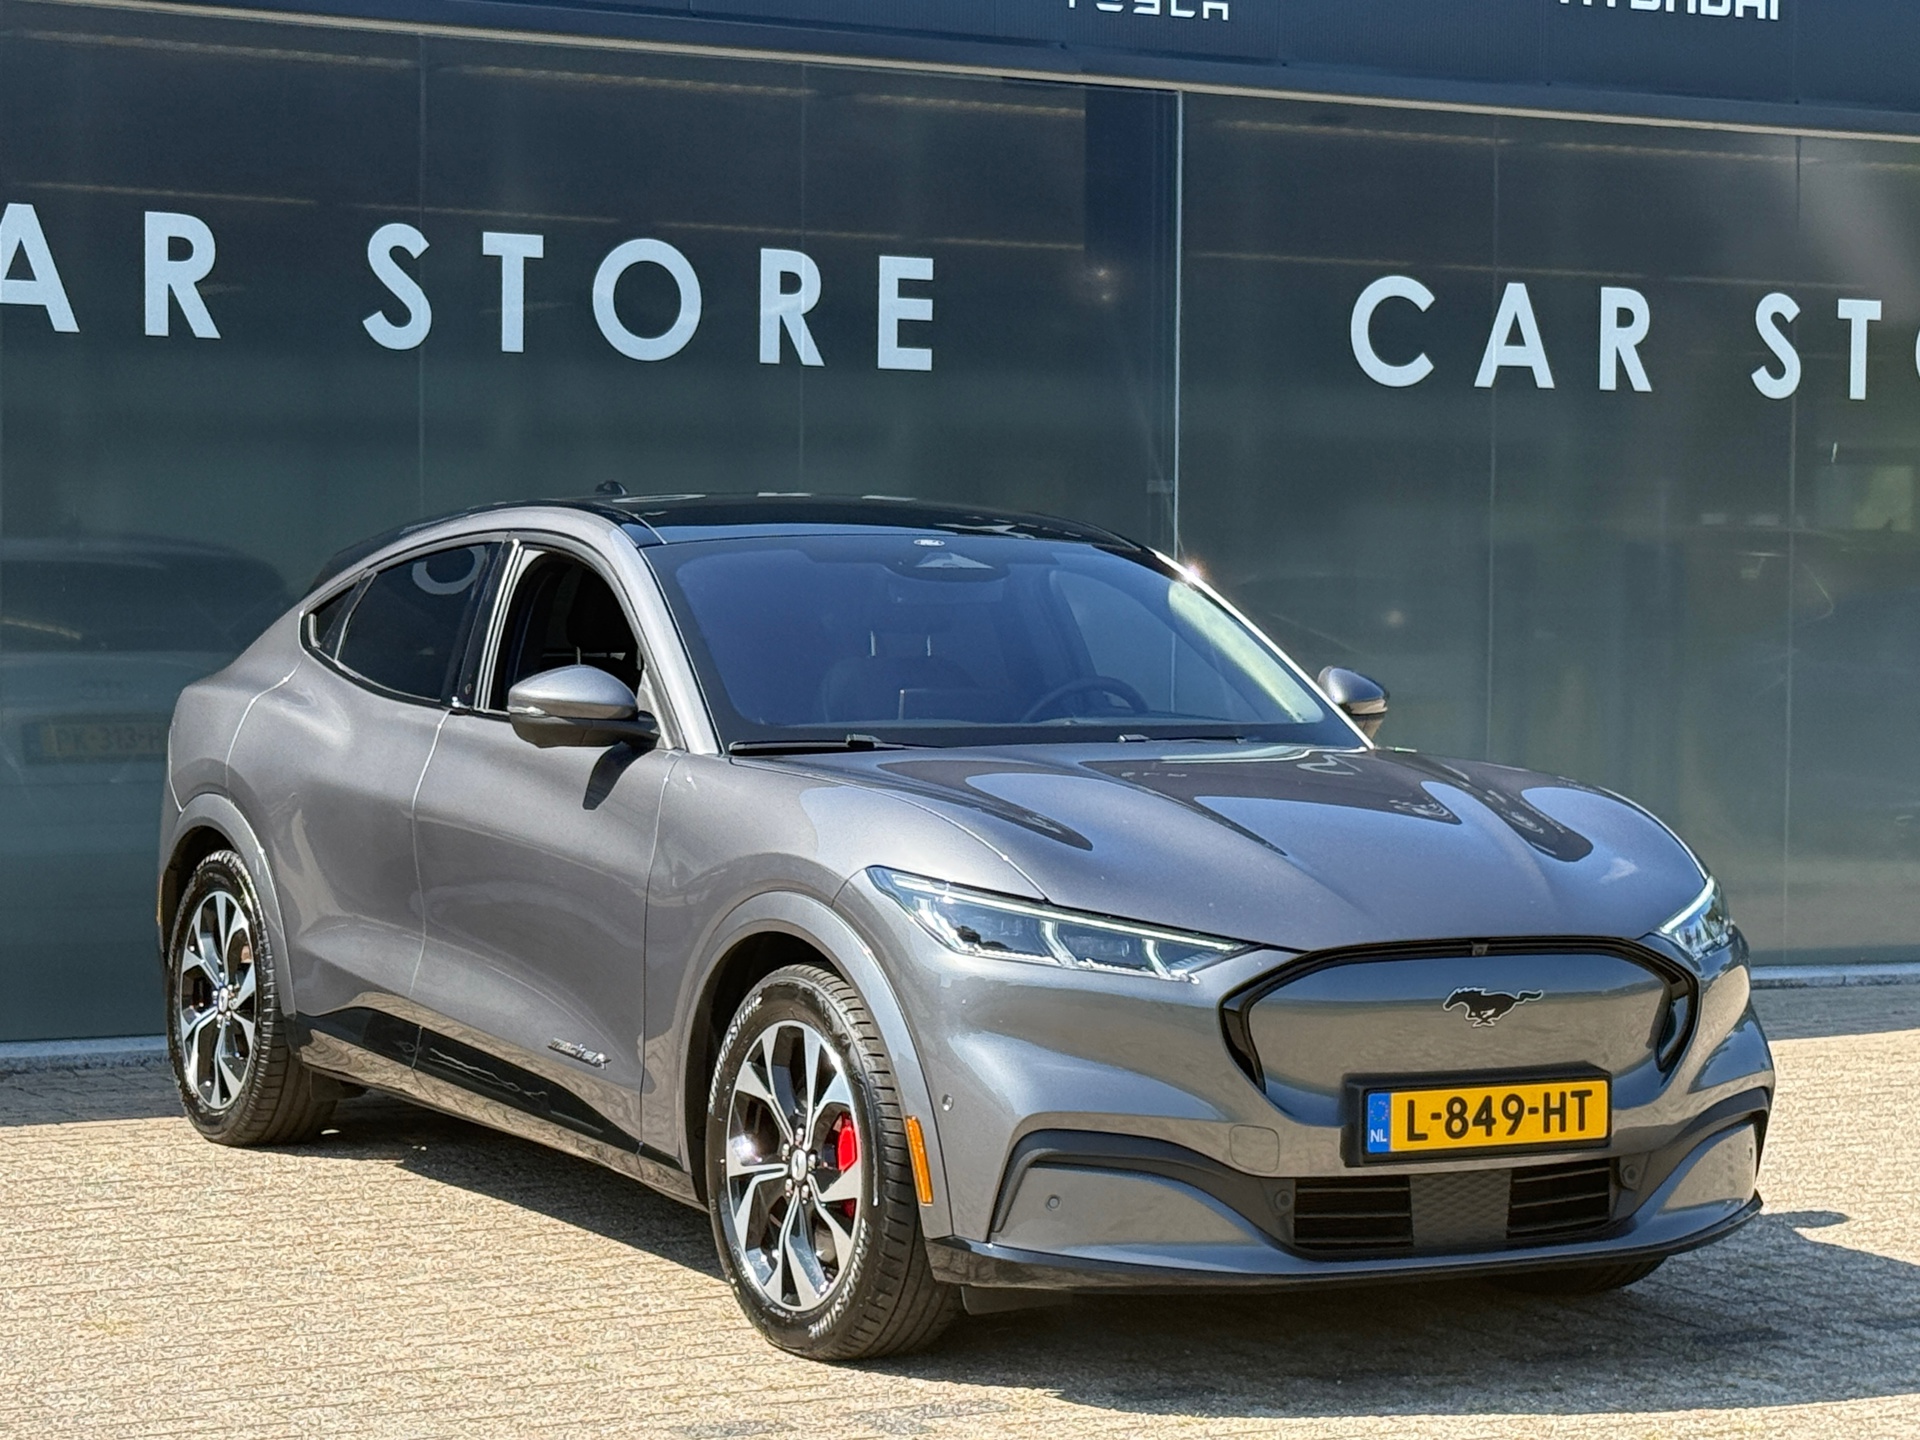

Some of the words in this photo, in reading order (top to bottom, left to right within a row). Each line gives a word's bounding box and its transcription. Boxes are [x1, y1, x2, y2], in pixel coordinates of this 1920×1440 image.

[1068, 0, 1229, 21] SLA
[363, 223, 934, 371] STORE
[1351, 276, 1653, 393] CAR
[1752, 293, 1920, 400] ST
[1370, 1129, 1388, 1143] NL
[1406, 1089, 1593, 1142] L-849-HT
